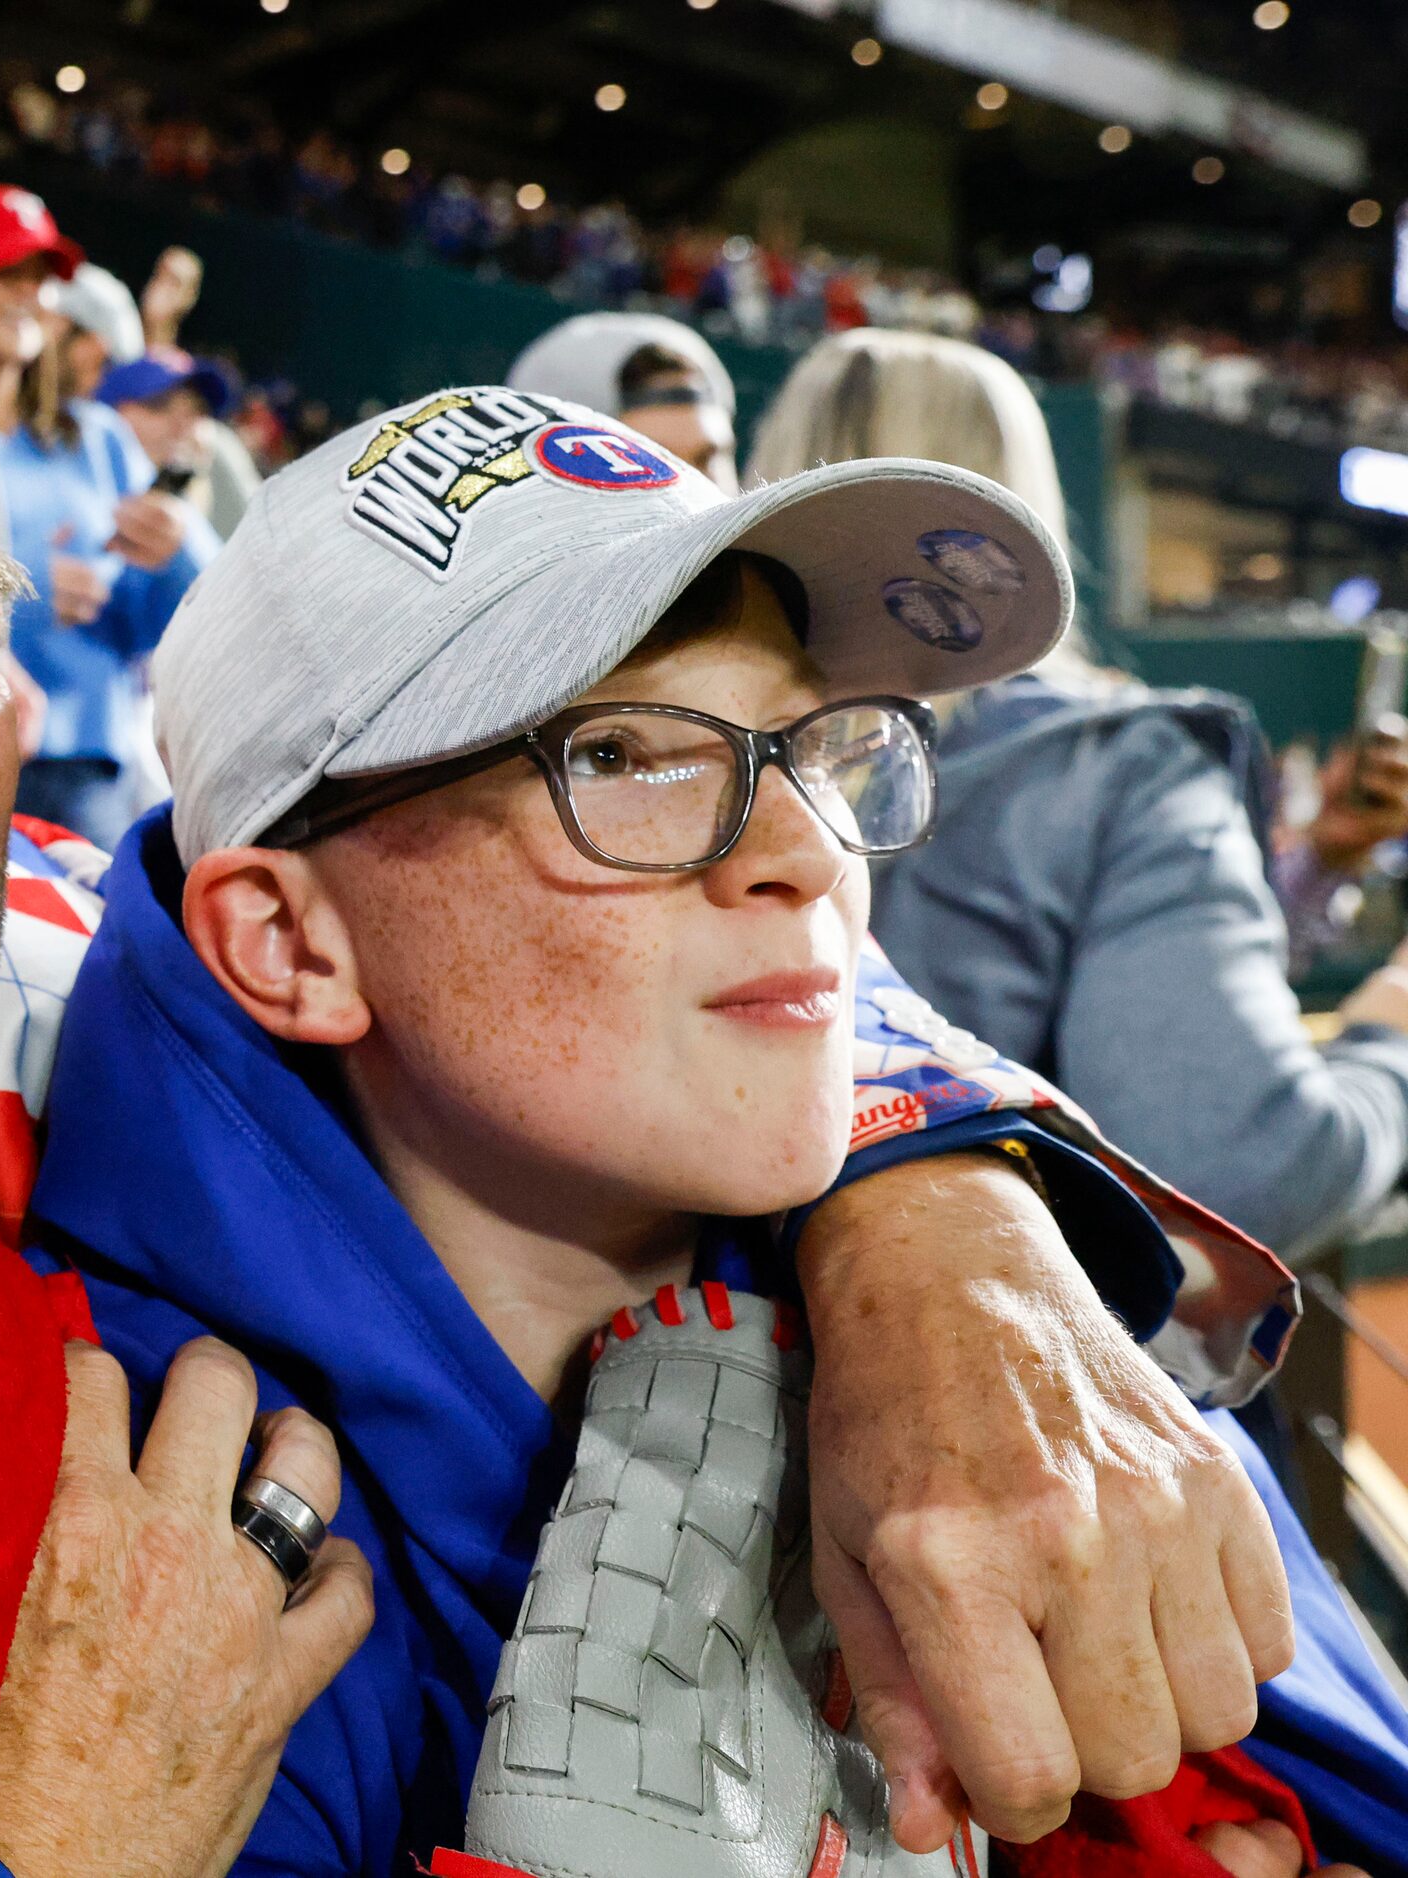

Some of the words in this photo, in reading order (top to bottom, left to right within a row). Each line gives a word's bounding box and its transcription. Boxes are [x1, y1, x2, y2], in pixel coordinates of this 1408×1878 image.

[353, 391, 548, 564] WORLD
[553, 434, 657, 477] T
[851, 1079, 976, 1133] angers
